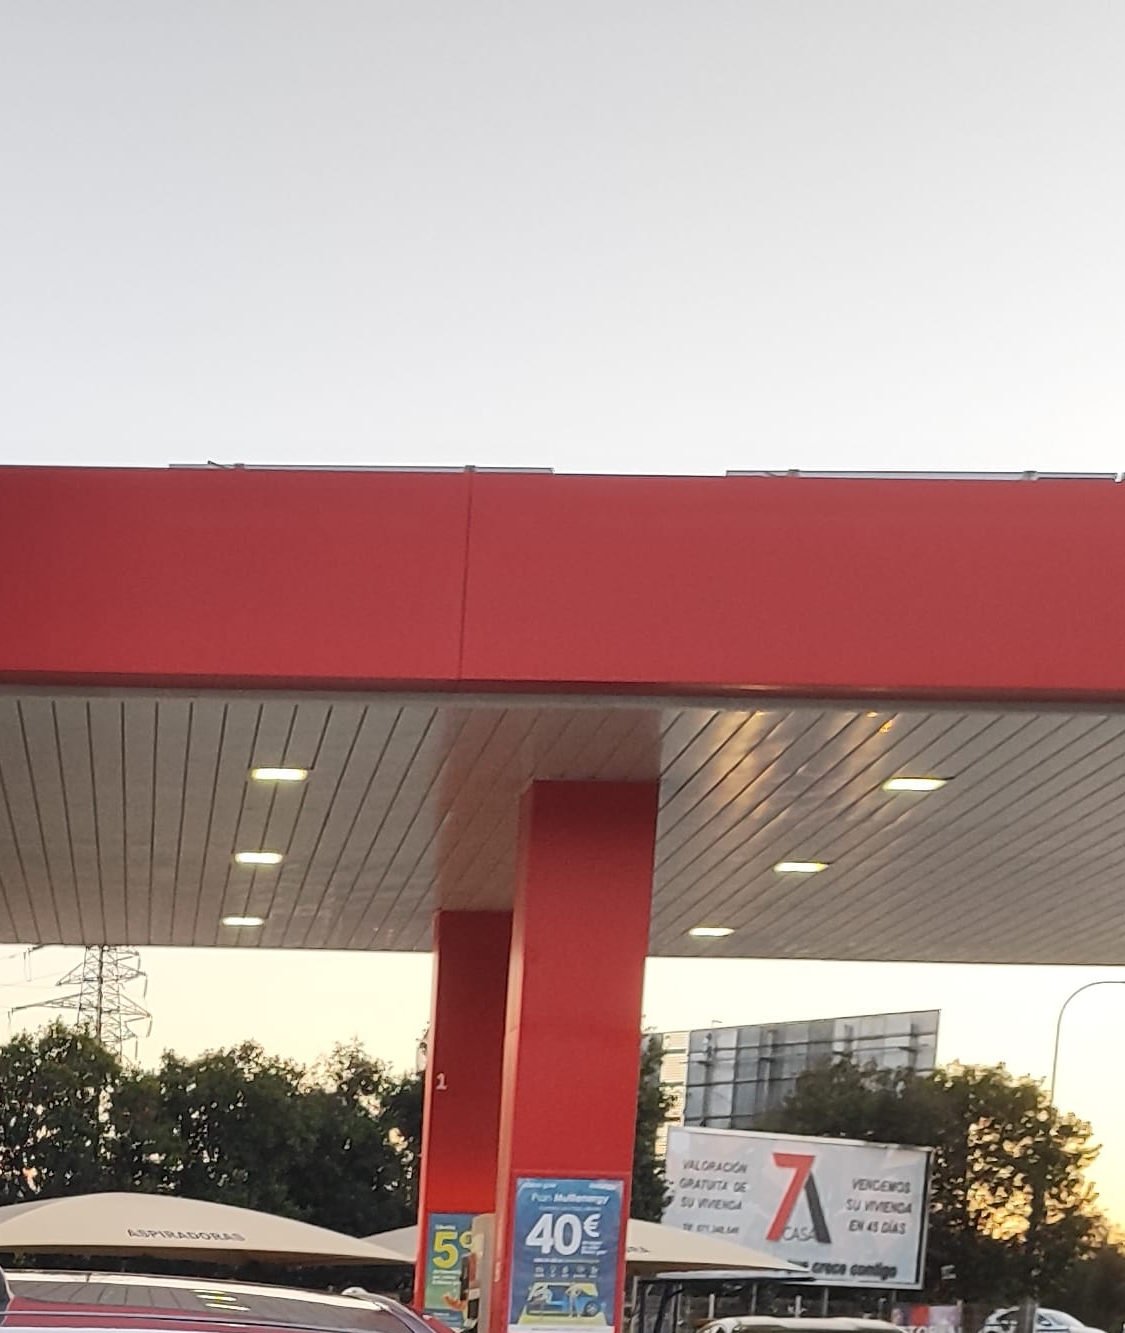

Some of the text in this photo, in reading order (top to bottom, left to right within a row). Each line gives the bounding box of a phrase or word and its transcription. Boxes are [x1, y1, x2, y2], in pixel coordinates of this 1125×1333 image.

[436, 1072, 447, 1090] 1
[679, 1178, 748, 1193] GRATUITA DE
[852, 1178, 911, 1193] VENDEMOS
[680, 1197, 743, 1210] SU VIVIENDA
[846, 1199, 913, 1214] SU VIVIENDA
[848, 1219, 864, 1232] EN
[127, 1228, 246, 1241] ASPIRADORAS
[850, 1262, 897, 1280] contigo
